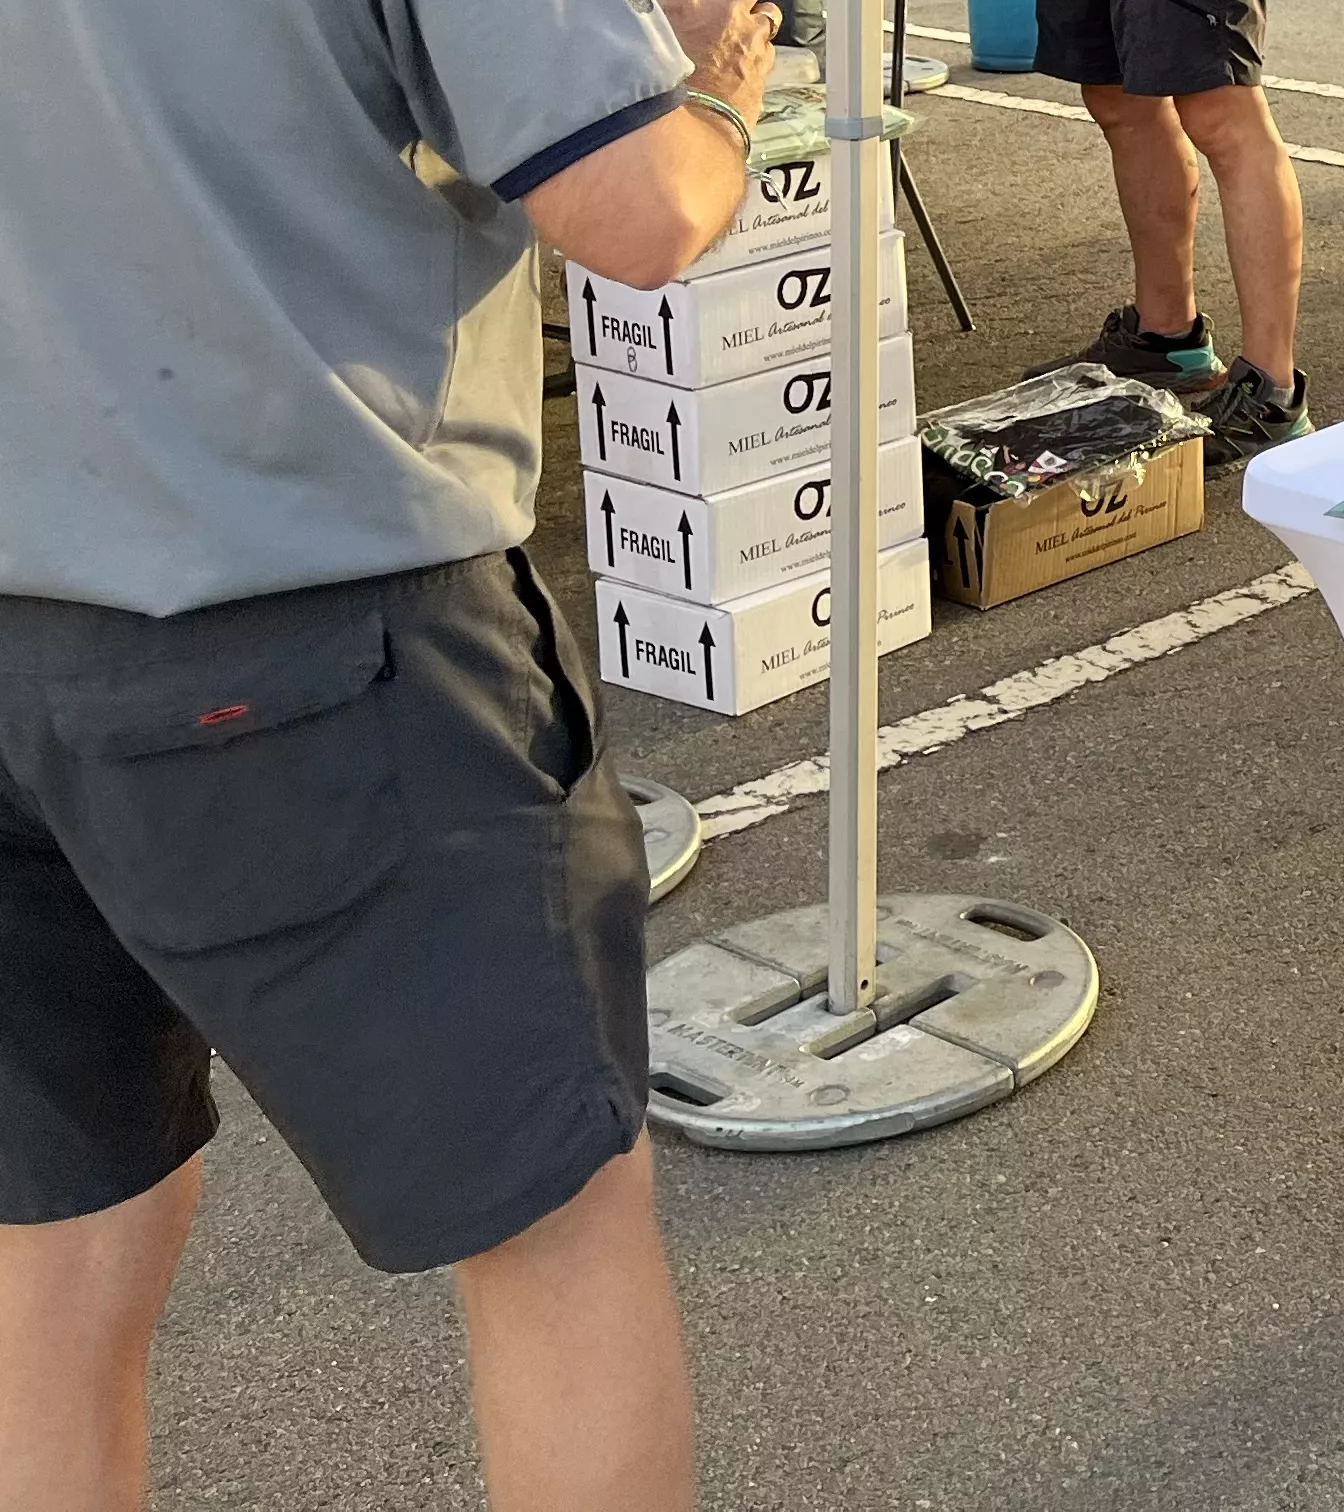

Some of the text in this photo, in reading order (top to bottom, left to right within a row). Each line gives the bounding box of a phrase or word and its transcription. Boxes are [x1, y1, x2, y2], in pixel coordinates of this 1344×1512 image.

[761, 160, 821, 203] OZ
[752, 199, 829, 230] Artesanal del
[601, 315, 657, 350] FRAGIL
[721, 309, 826, 351] MIEL Artesanal
[611, 420, 665, 456] FRAGIL
[728, 432, 772, 456] MIEL
[620, 527, 676, 563] FRAGIL
[739, 539, 782, 564] MIEL
[1034, 533, 1070, 555] MIEL
[635, 638, 697, 676] FRAGIL
[761, 648, 801, 674] MIEL
